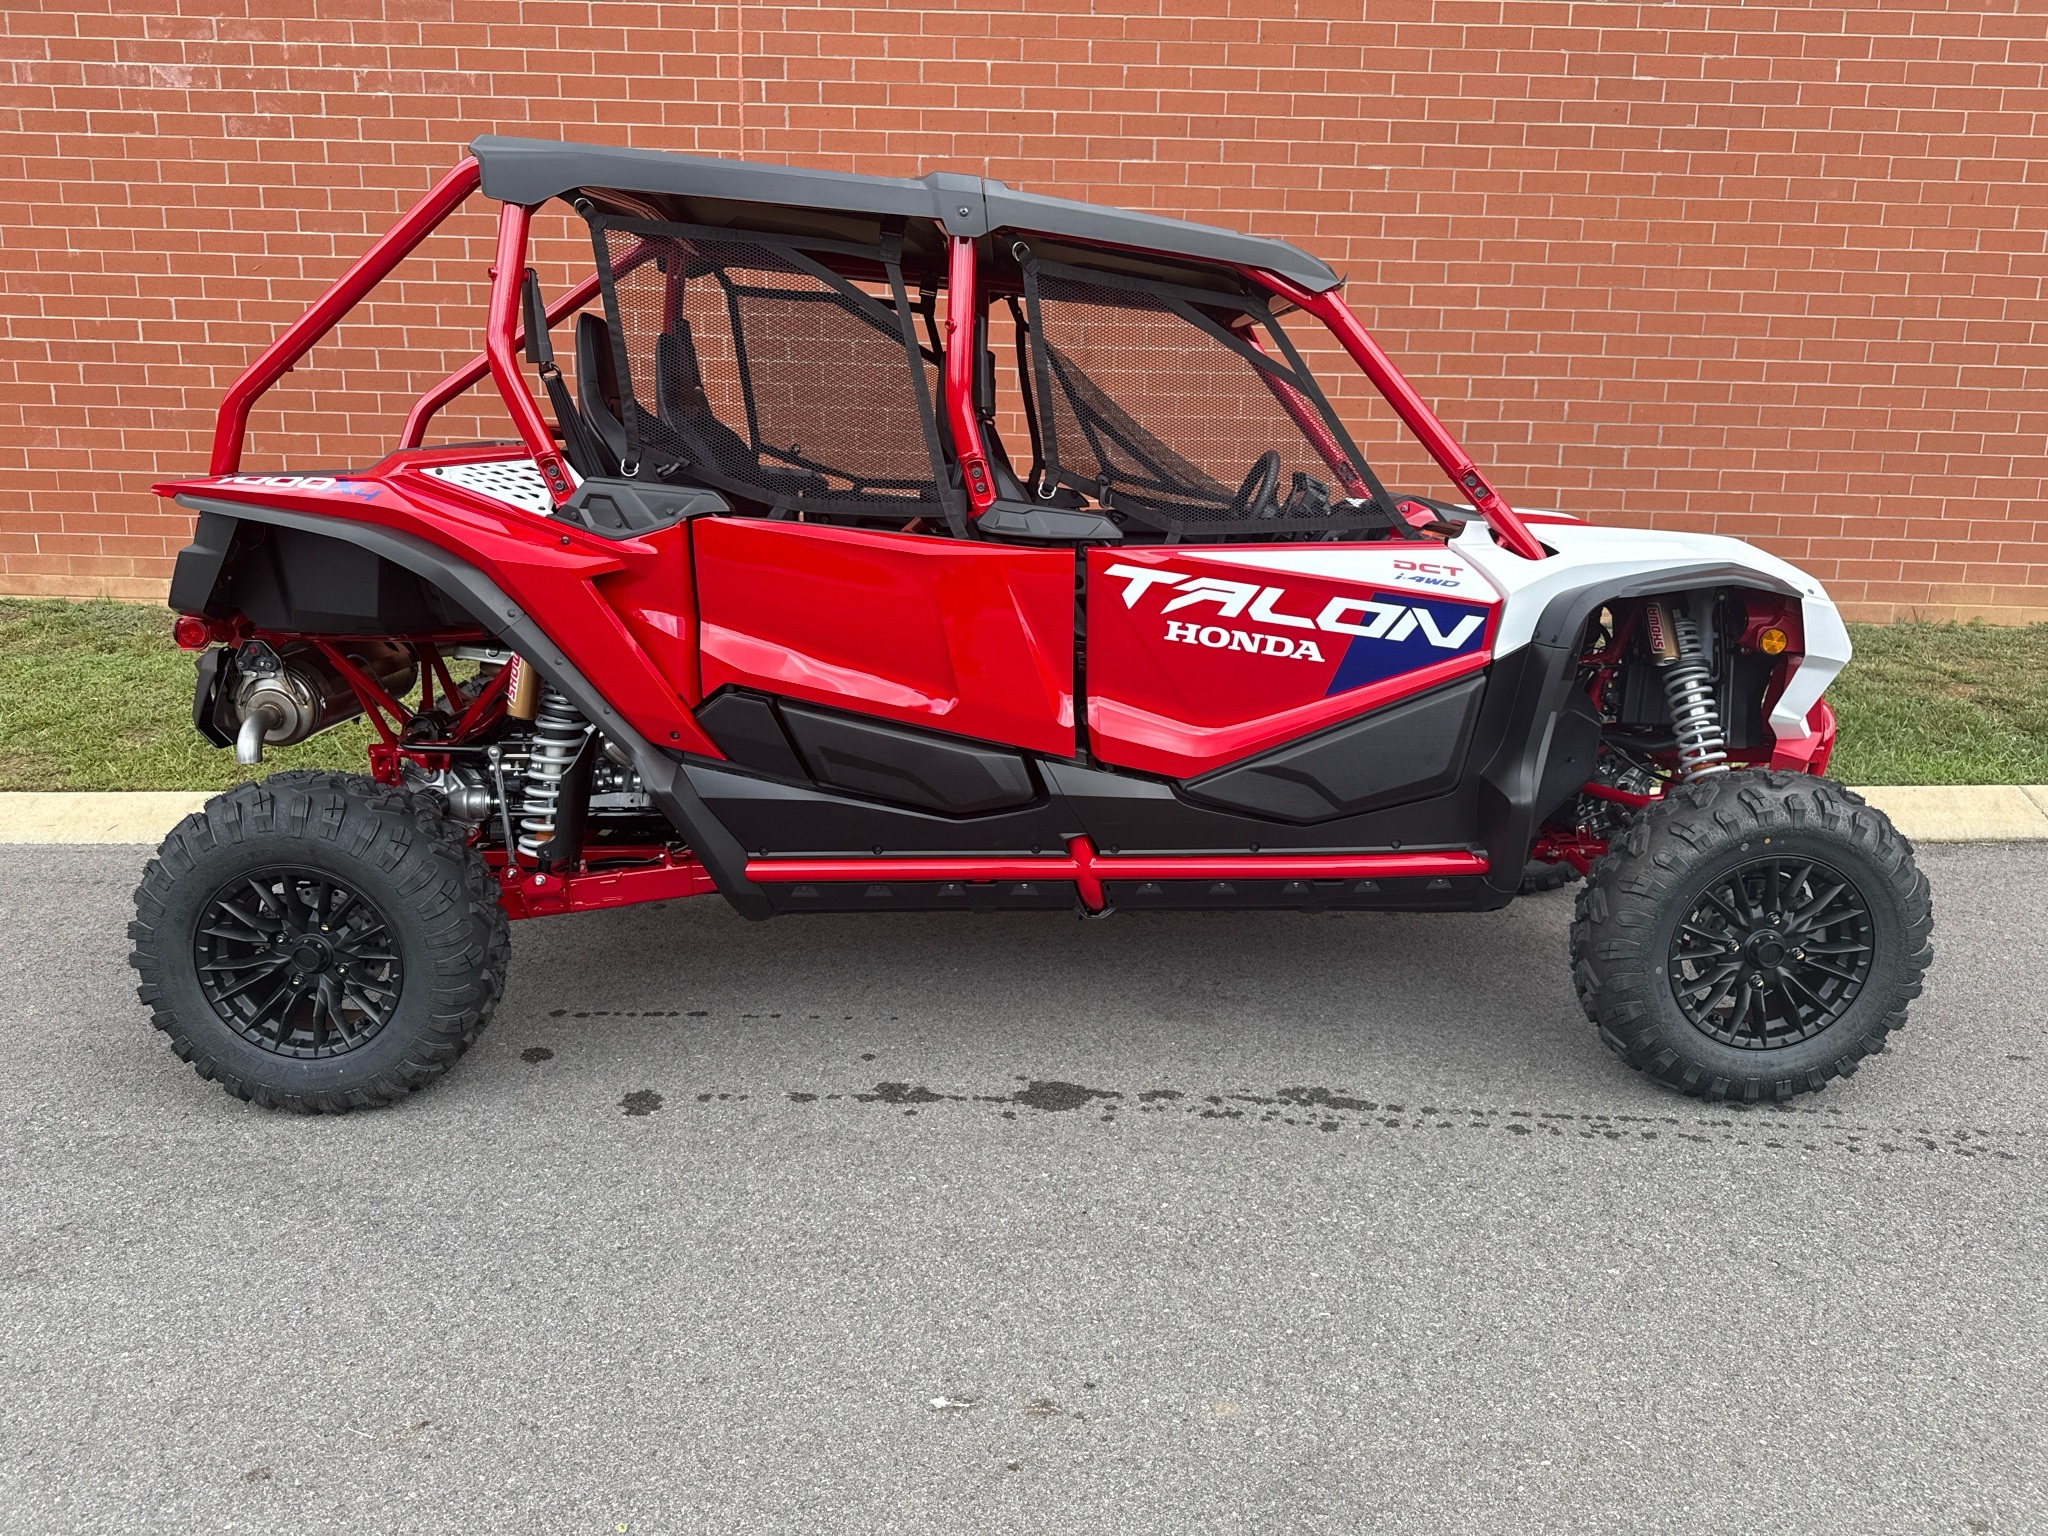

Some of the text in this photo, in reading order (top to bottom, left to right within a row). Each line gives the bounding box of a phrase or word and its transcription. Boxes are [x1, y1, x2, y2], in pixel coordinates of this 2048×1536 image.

[1394, 560, 1463, 577] DCT
[1103, 563, 1485, 649] TALON
[1647, 607, 1665, 650] SHOWA
[1163, 620, 1326, 663] HONDA
[508, 651, 522, 703] SHOW
[1840, 927, 1900, 1033] KENDA
[184, 1006, 291, 1083] KENDA
